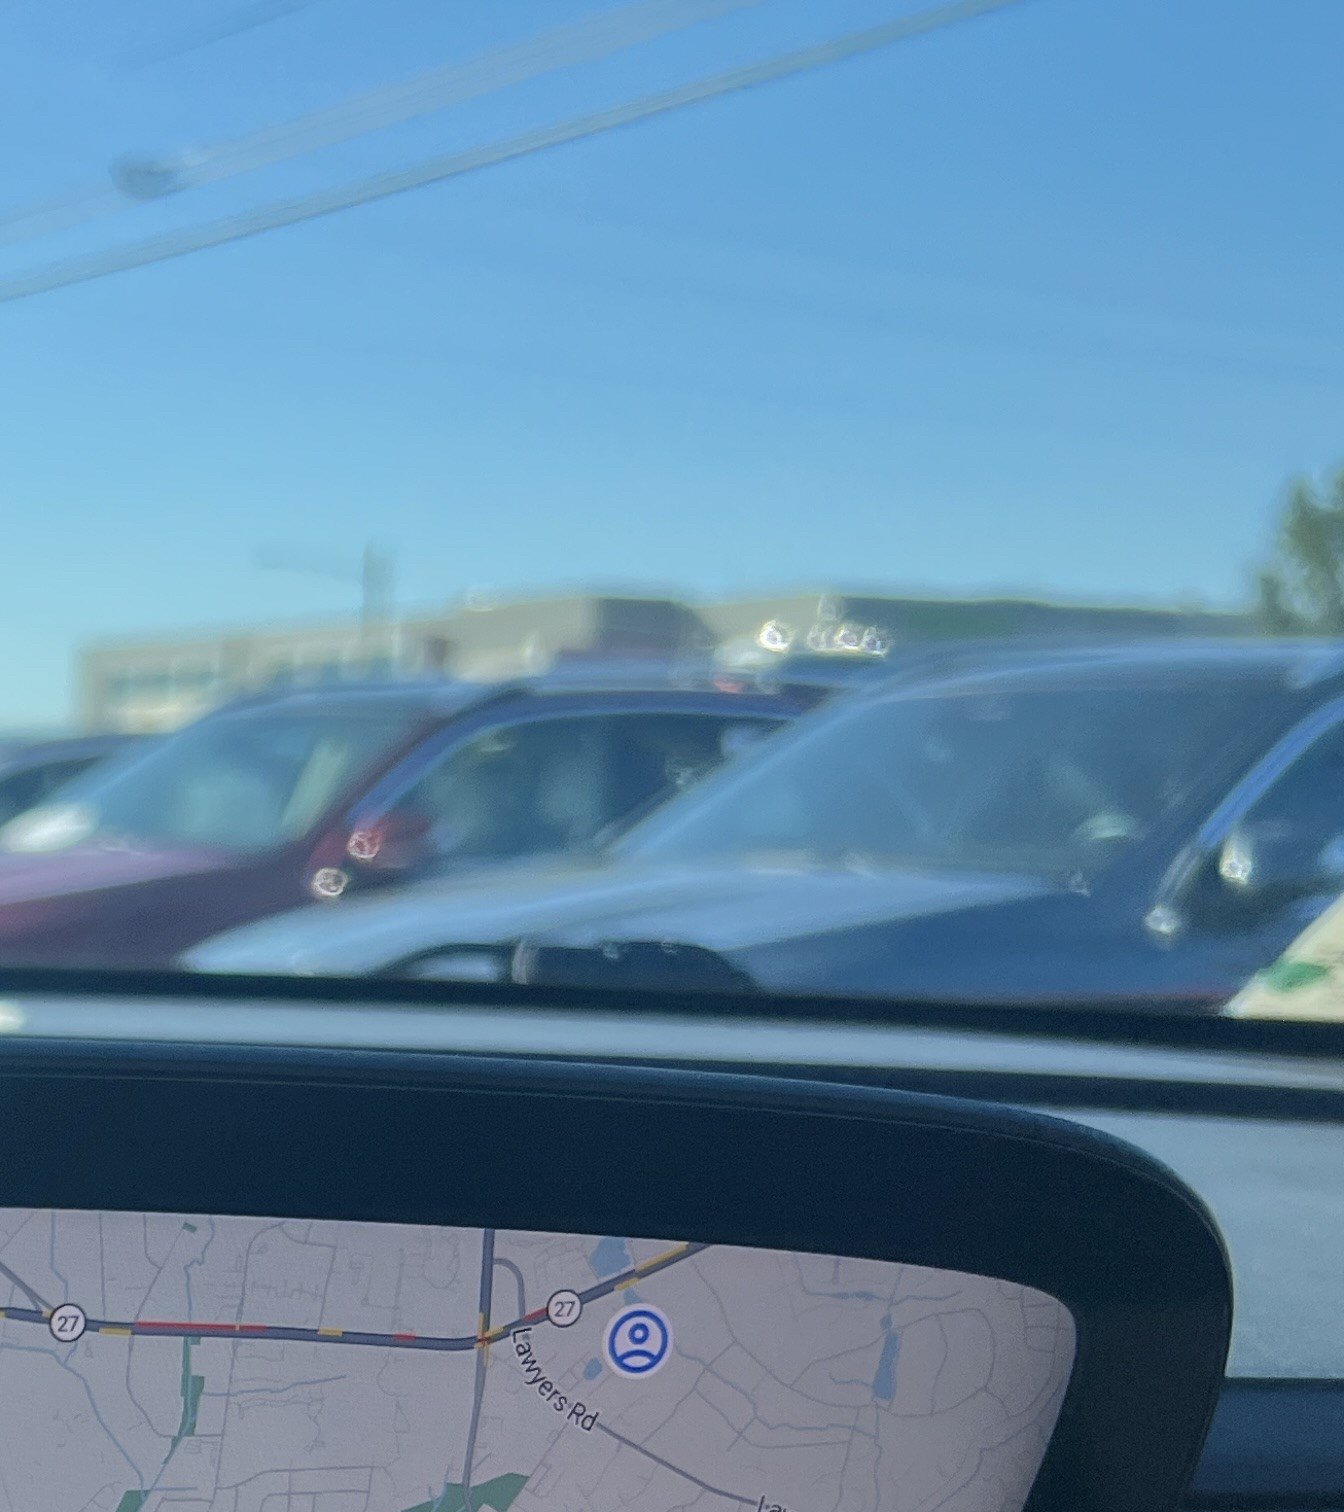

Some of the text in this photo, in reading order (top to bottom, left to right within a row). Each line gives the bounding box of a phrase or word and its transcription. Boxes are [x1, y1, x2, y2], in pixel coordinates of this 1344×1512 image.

[554, 1300, 576, 1318] 27
[57, 1314, 80, 1333] 27
[511, 1325, 598, 1433] Lawyers Rd
